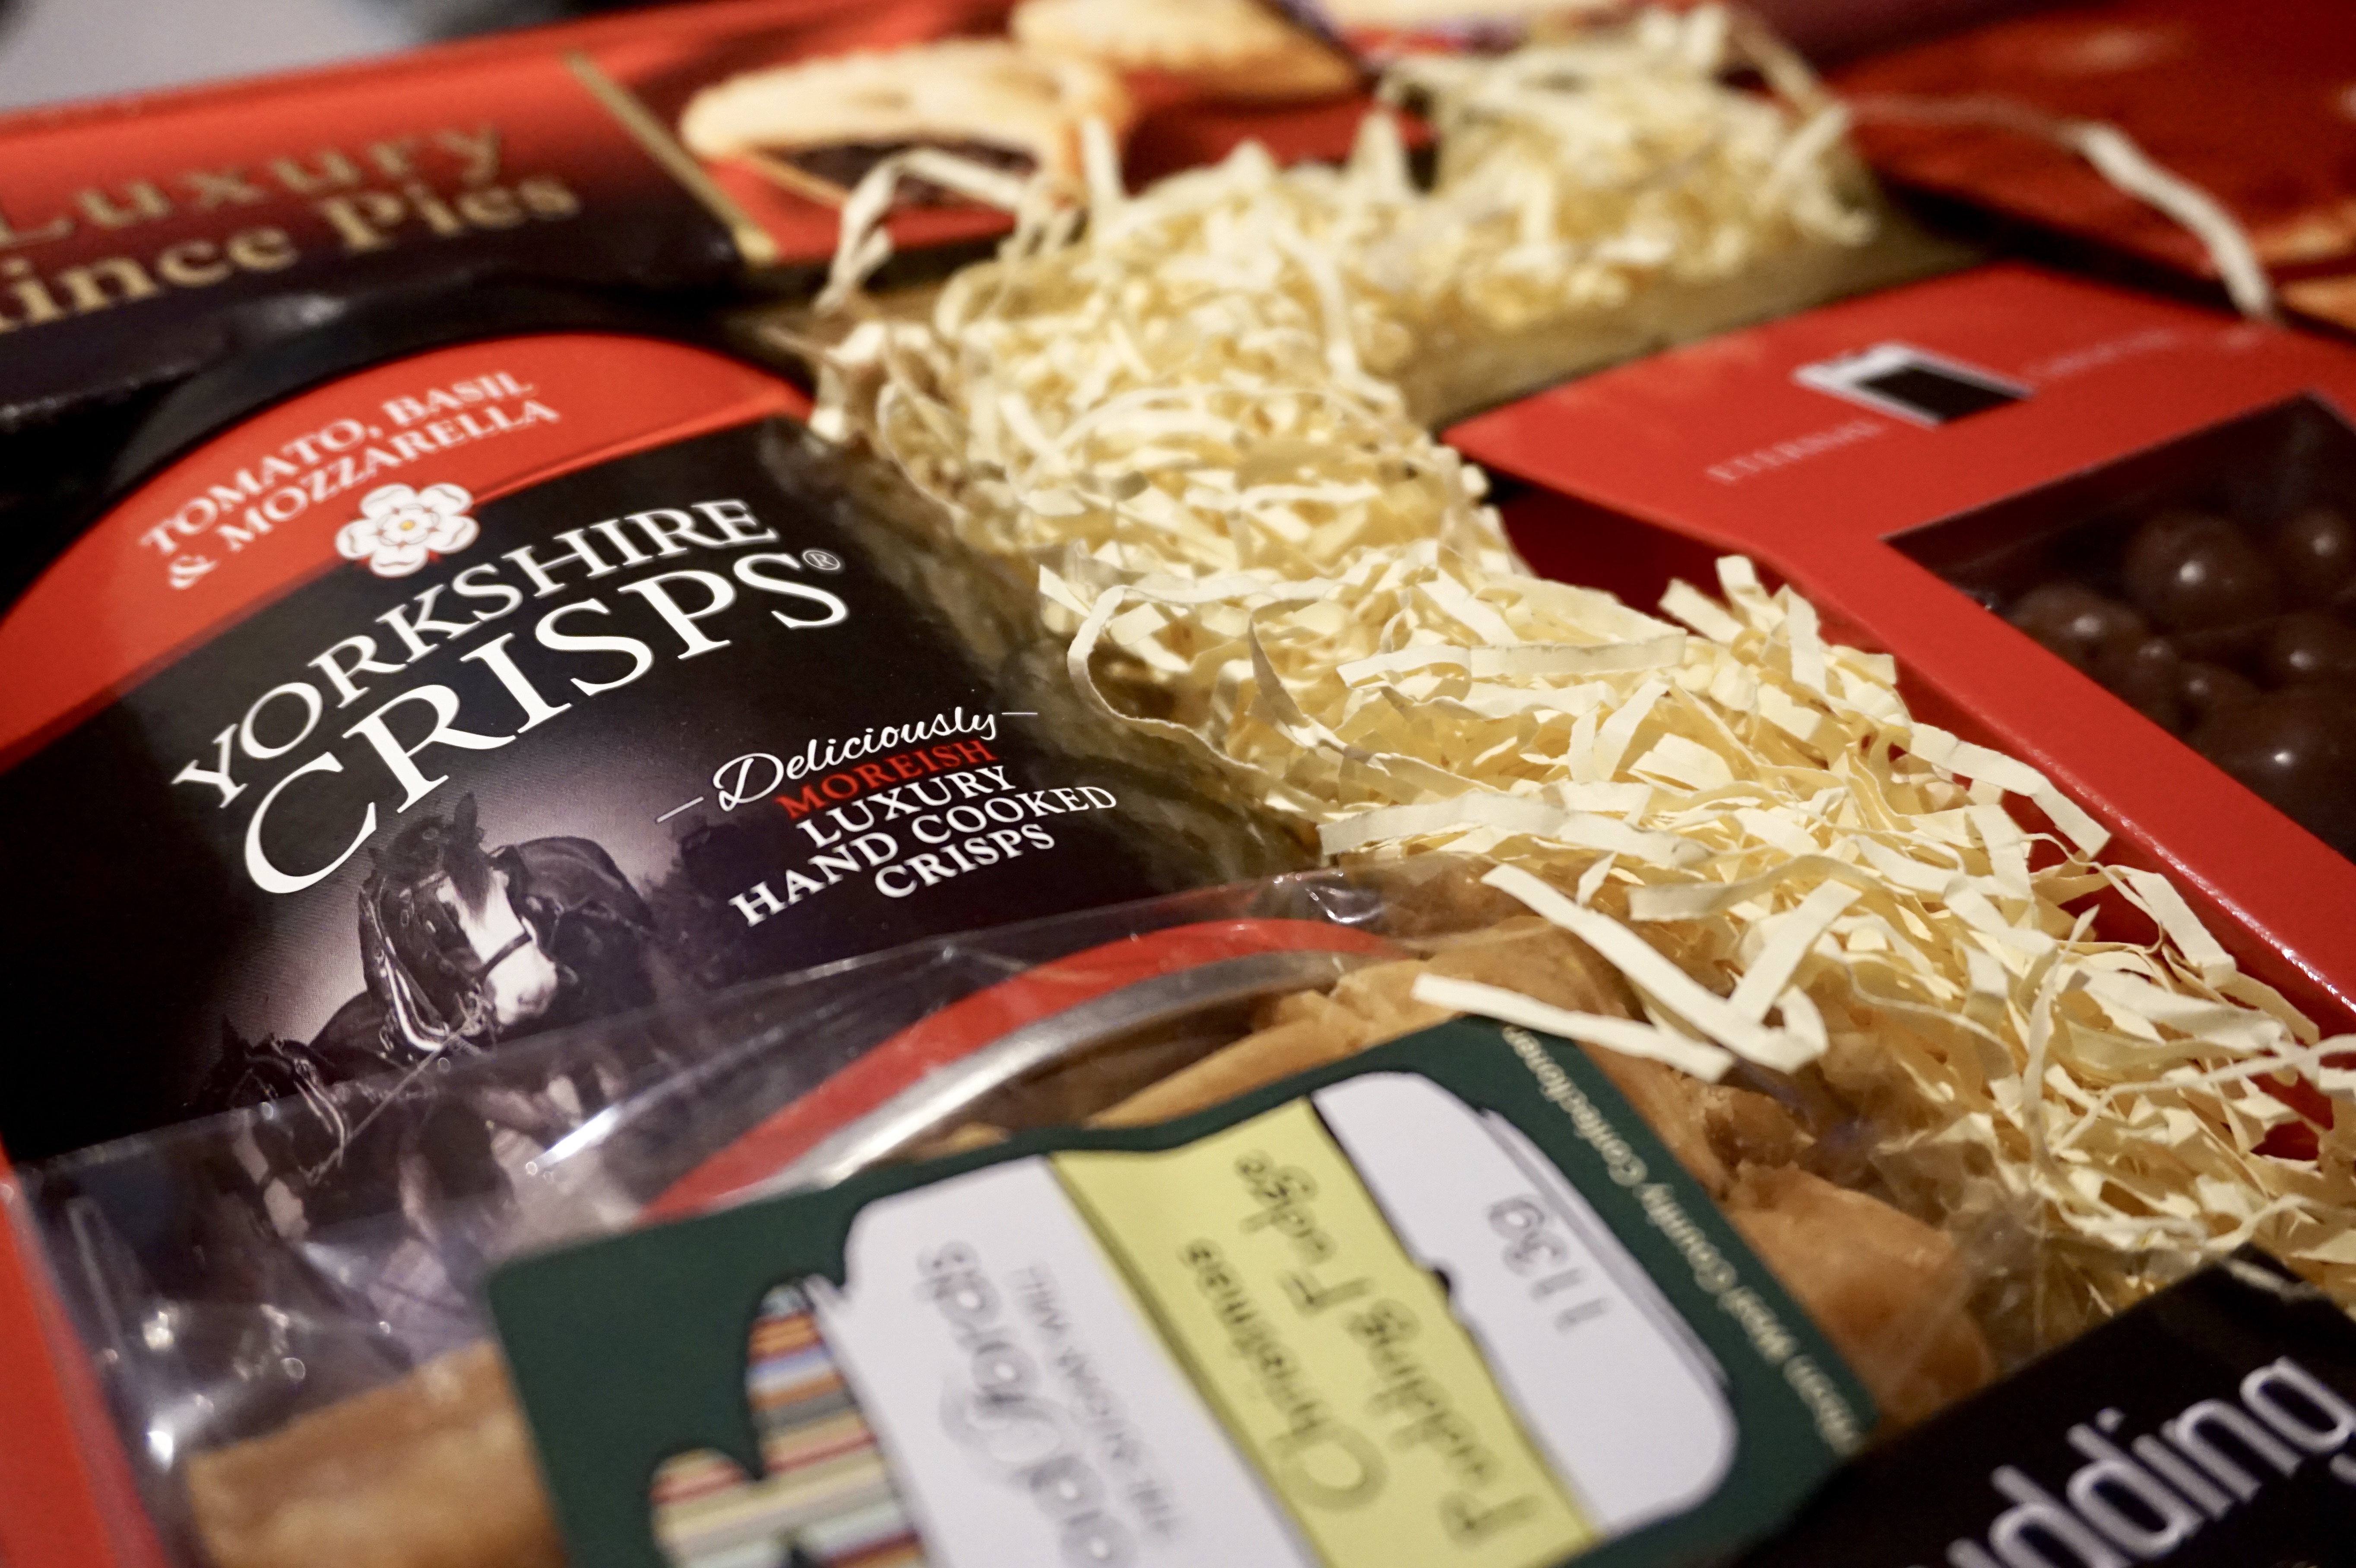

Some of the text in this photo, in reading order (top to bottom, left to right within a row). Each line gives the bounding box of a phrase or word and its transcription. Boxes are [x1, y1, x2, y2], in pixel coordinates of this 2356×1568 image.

[0, 179, 581, 333] ince Pies
[139, 370, 534, 554] TOMATO, BASIL
[166, 399, 561, 591] & MOZZARELLA
[171, 497, 781, 809] YORKSHIRE
[712, 706, 998, 812] Deliciously
[774, 739, 998, 820] MOREISH
[796, 765, 1016, 849] LUXURY
[729, 785, 1118, 927] HAND COOKED
[874, 823, 1056, 899] CRISPS
[1487, 1194, 1609, 1335] 113g
[1178, 1236, 1389, 1512] Christmas
[1234, 1148, 1548, 1549] Pudding Fudge
